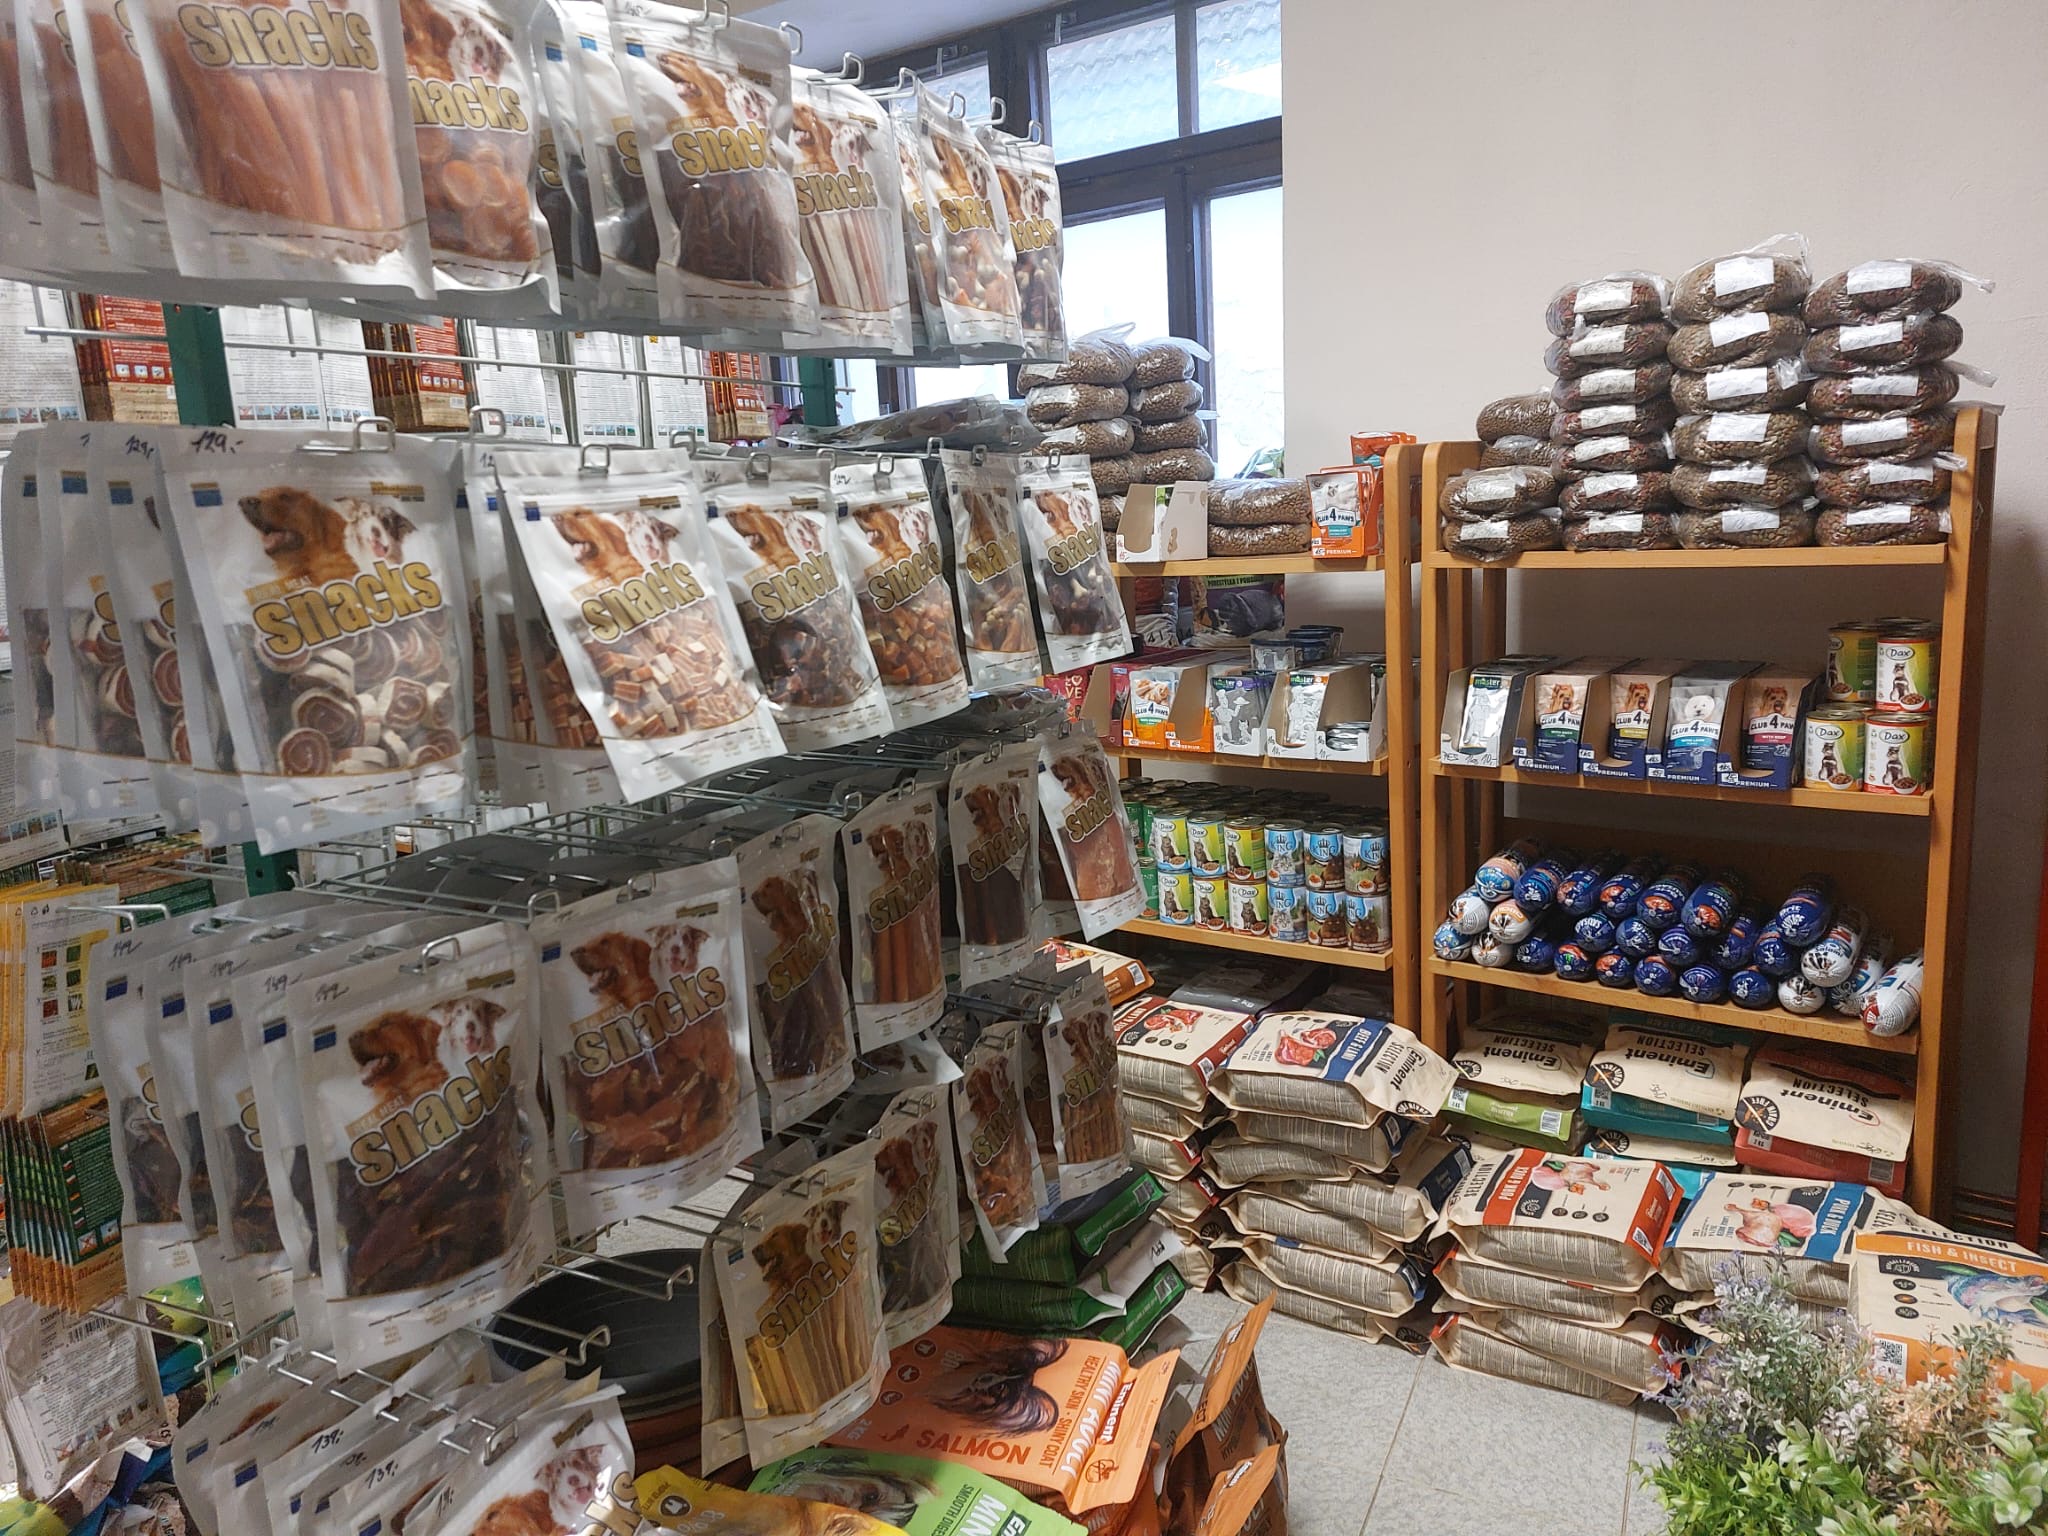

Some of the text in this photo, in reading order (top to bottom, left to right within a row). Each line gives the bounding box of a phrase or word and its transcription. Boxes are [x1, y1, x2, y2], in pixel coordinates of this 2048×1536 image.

[177, 1, 379, 70] snacks
[411, 76, 530, 132] nacks
[1329, 508, 1336, 521] 4
[1338, 514, 1354, 522] PAWS
[253, 561, 442, 655] snacks
[581, 562, 704, 641] snacks
[1890, 648, 1911, 657] Dax
[1475, 677, 1500, 688] master
[1148, 702, 1154, 714] 4
[1558, 711, 1566, 725] 4
[1616, 716, 1632, 725] CLUB
[1633, 711, 1642, 724] 4
[1671, 721, 1719, 736] CLUB 4 PAWS
[1751, 721, 1768, 730] CLUB
[1769, 714, 1779, 729] 4
[1819, 728, 1840, 737] Dax
[1884, 731, 1905, 740] Dax
[1311, 845, 1336, 857] KING
[1199, 884, 1212, 892] Dax
[1311, 903, 1335, 914] KING
[574, 966, 726, 1076] snacks
[1355, 1029, 1372, 1043] BEEF
[1493, 1035, 1556, 1052] SELECTION
[1637, 1035, 1706, 1056] SELECTION
[1376, 1041, 1403, 1074] SELECTION
[1483, 1046, 1558, 1067] Eminent
[1625, 1048, 1711, 1075] Eminent
[1389, 1050, 1424, 1092] Eminent
[1792, 1077, 1869, 1108] SELECTION
[1751, 1096, 1778, 1127] GRAIN FREE
[1780, 1088, 1875, 1123] Eminent
[1463, 1162, 1496, 1198] SELECTION
[1499, 1166, 1530, 1201] PORK & DUCK
[1831, 1198, 1851, 1214] PORK
[1820, 1219, 1844, 1236] DUCK
[1910, 1226, 2009, 1249] SELECTION
[1907, 1241, 2017, 1273] FISH & INSECT
[1038, 1355, 1100, 1469] HEALTHY SKIN SHINY COAT
[1060, 1360, 1121, 1477] MINI ADULT
[1100, 1382, 1134, 1442] Eminent
[916, 1429, 1031, 1466] SALMON
[948, 1483, 975, 1519] SMOOTH
